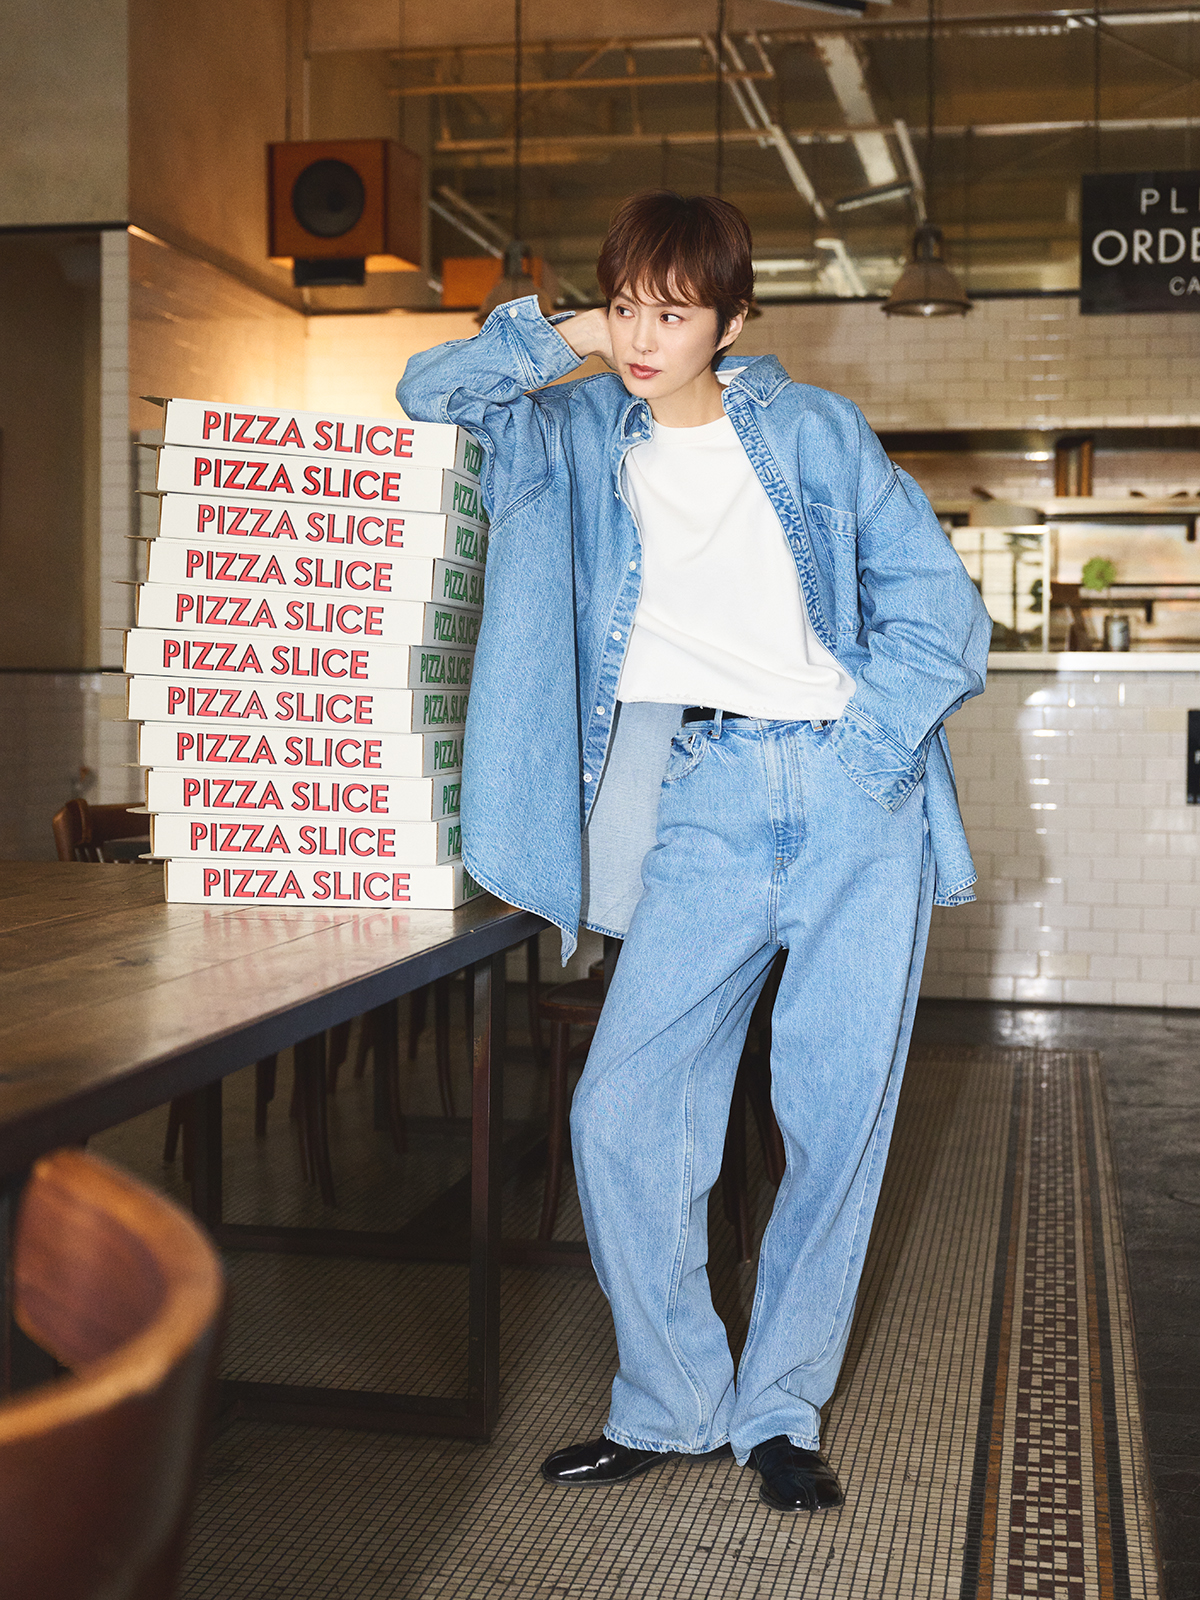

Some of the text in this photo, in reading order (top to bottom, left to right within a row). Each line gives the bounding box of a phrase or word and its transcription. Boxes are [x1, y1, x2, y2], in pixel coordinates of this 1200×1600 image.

[1140, 187, 1200, 215] PL
[202, 410, 414, 458] PIZZA SLICE
[193, 457, 400, 502] PIZZA SLICE
[453, 481, 478, 519] PIZZA
[198, 504, 404, 548] PIZZA SLICE
[455, 525, 478, 562] PIZZA
[186, 549, 392, 592] PIZZA SLICE
[444, 568, 468, 602] PIZZA
[175, 593, 383, 636] PIZZA SLICE
[434, 611, 478, 645] PIZZA SLICE
[163, 639, 368, 680] PIZZA SLICE
[420, 653, 471, 684] PIZZA SLICE
[168, 686, 373, 725] PIZZA SLICE
[423, 695, 448, 724] PIZZA
[177, 732, 381, 769] PIZZA SLICE
[434, 739, 459, 770] PIZZA
[183, 778, 388, 814] PIZZA SLICE
[190, 822, 395, 858] PIZZA SLICE
[203, 868, 410, 902] PIZZA SLICE
